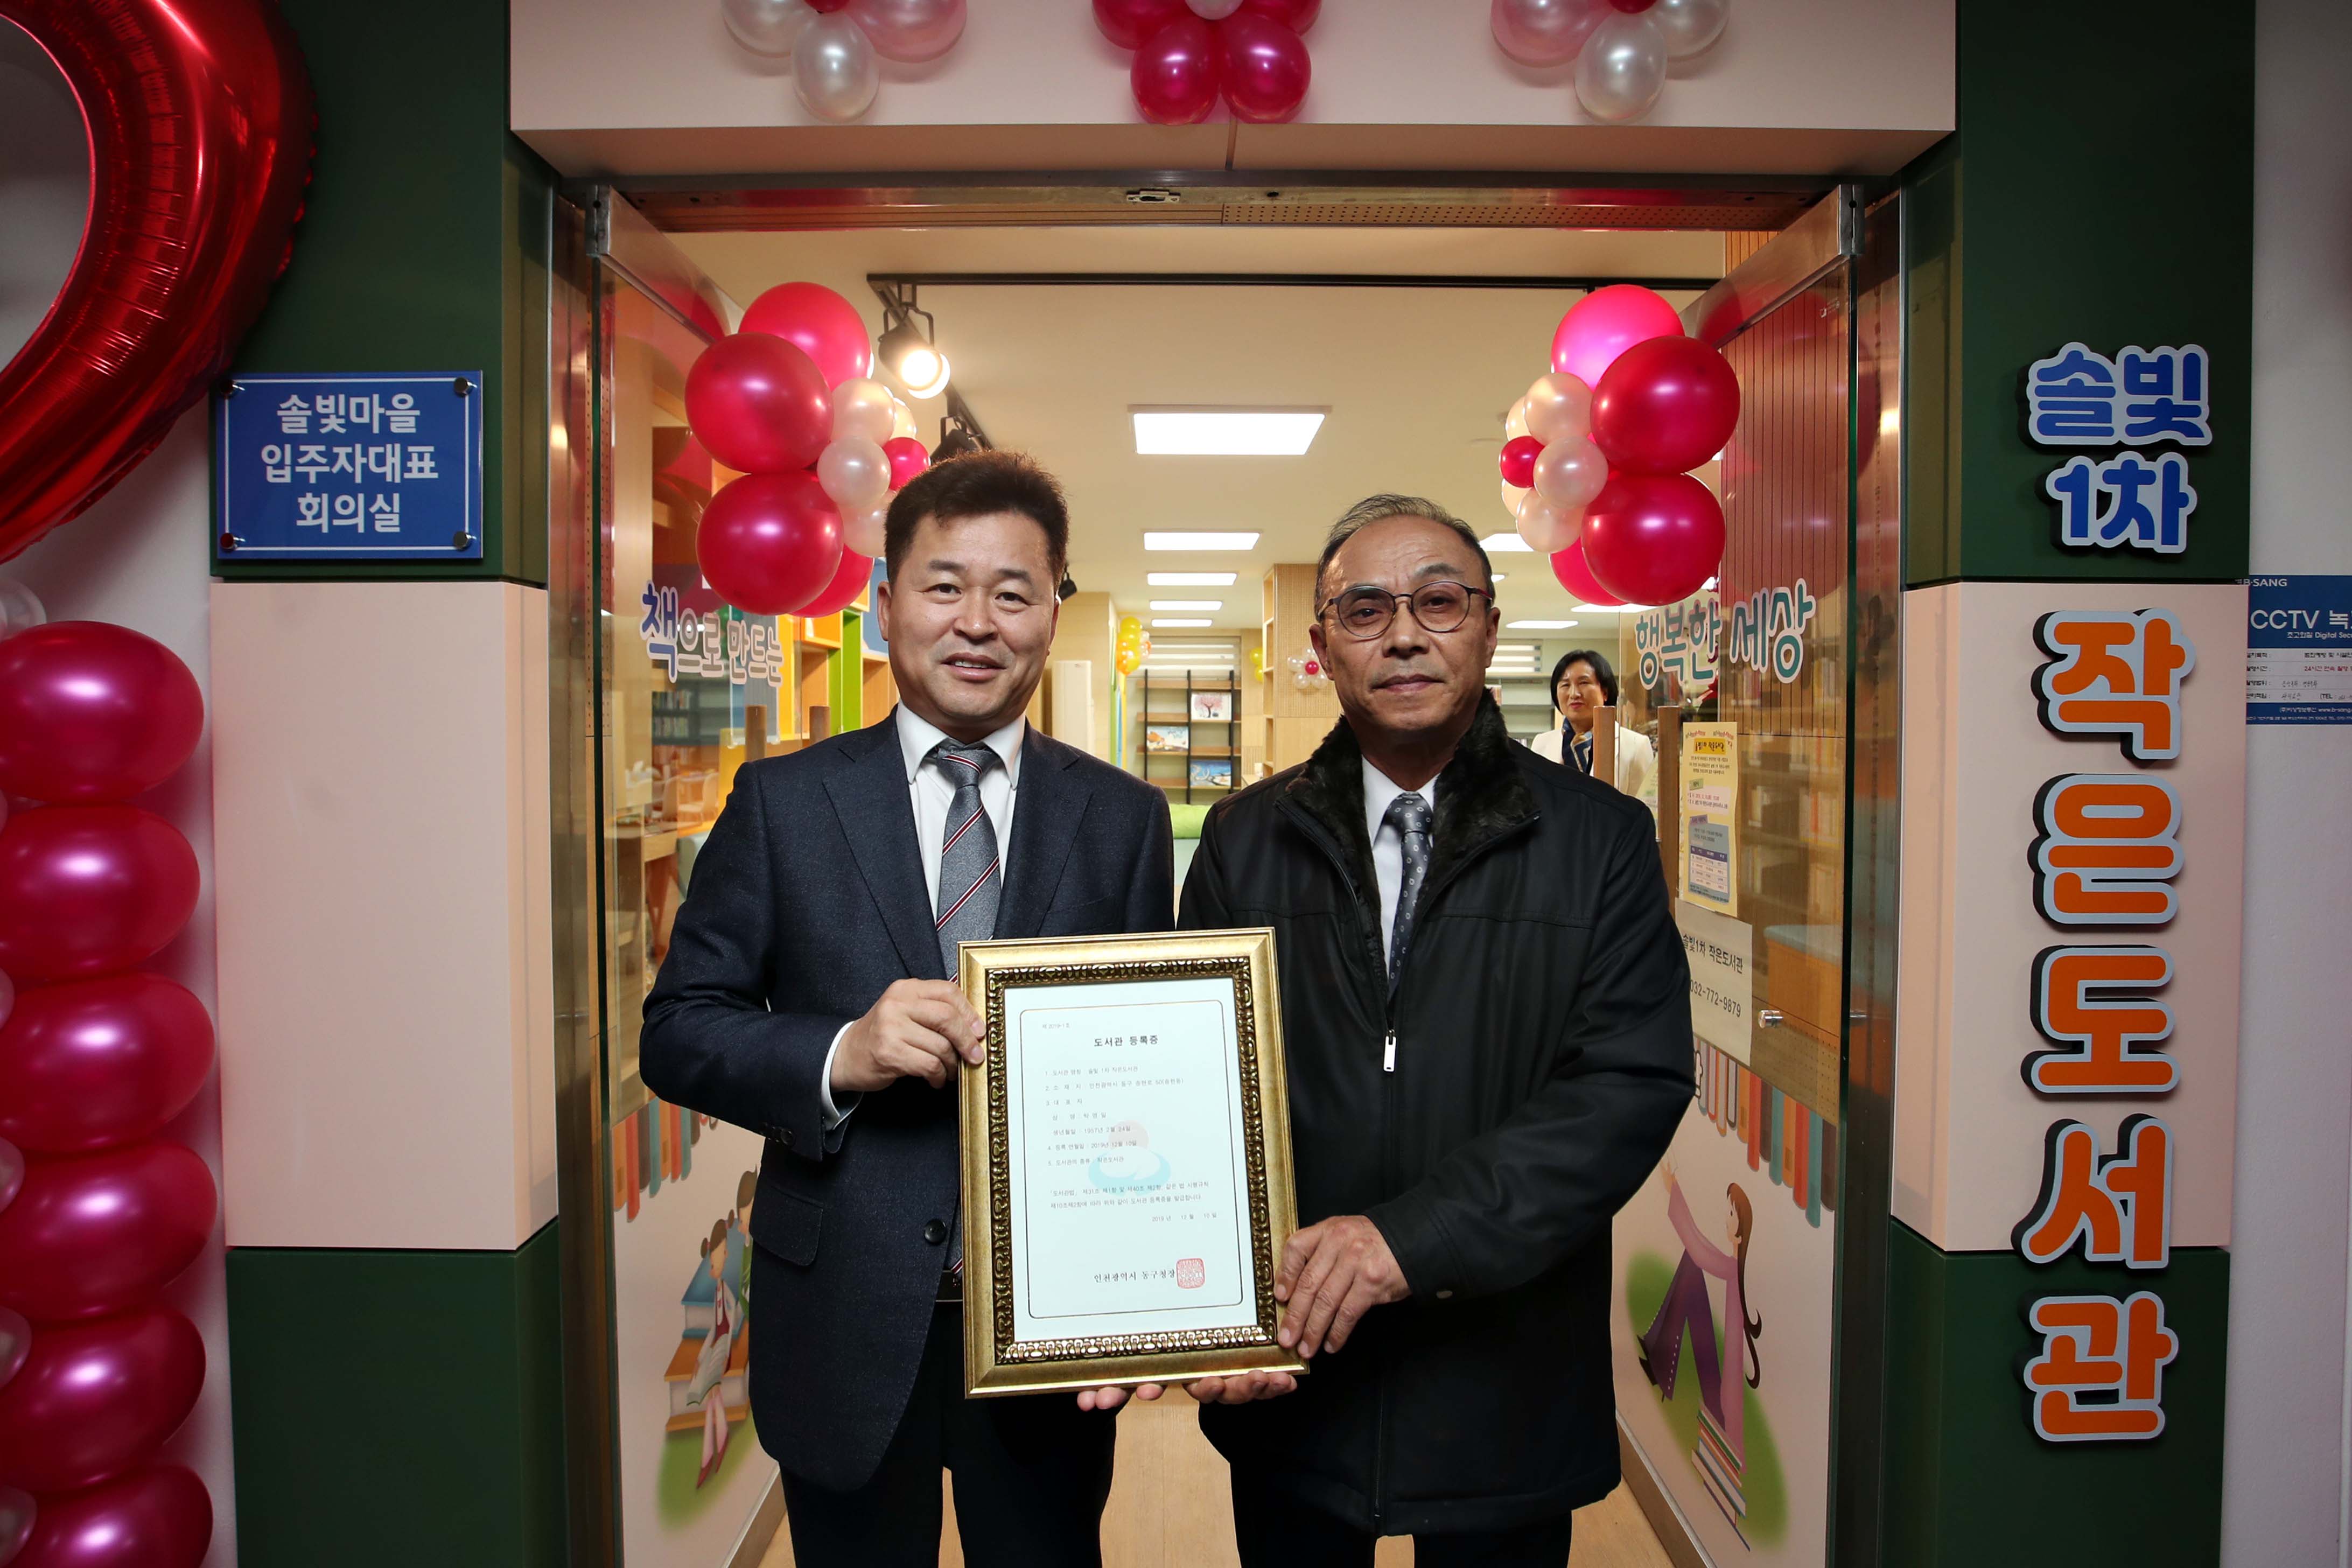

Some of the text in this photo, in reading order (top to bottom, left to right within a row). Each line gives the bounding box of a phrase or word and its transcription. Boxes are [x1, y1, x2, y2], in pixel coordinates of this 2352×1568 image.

[276, 393, 421, 434] 솔빛마을
[2027, 342, 2212, 445] 솔빛
[261, 443, 439, 484] 입주자대표
[296, 492, 401, 534] 회의실
[2046, 451, 2197, 553] 1차
[640, 580, 783, 687] 책으로 만드는
[1634, 578, 1816, 690] 행복한 세상
[2250, 610, 2352, 629] CCTV 녹
[2315, 632, 2337, 640] Digital
[1683, 933, 1744, 975] 솔빛1차 작은도서관
[1690, 979, 1741, 1018] 032-772-9879
[1094, 1035, 1159, 1047] 도서관 등록증
[2021, 608, 2195, 1441] 작은도서관
[1094, 1268, 1175, 1283] 인천광역시 동구청장
